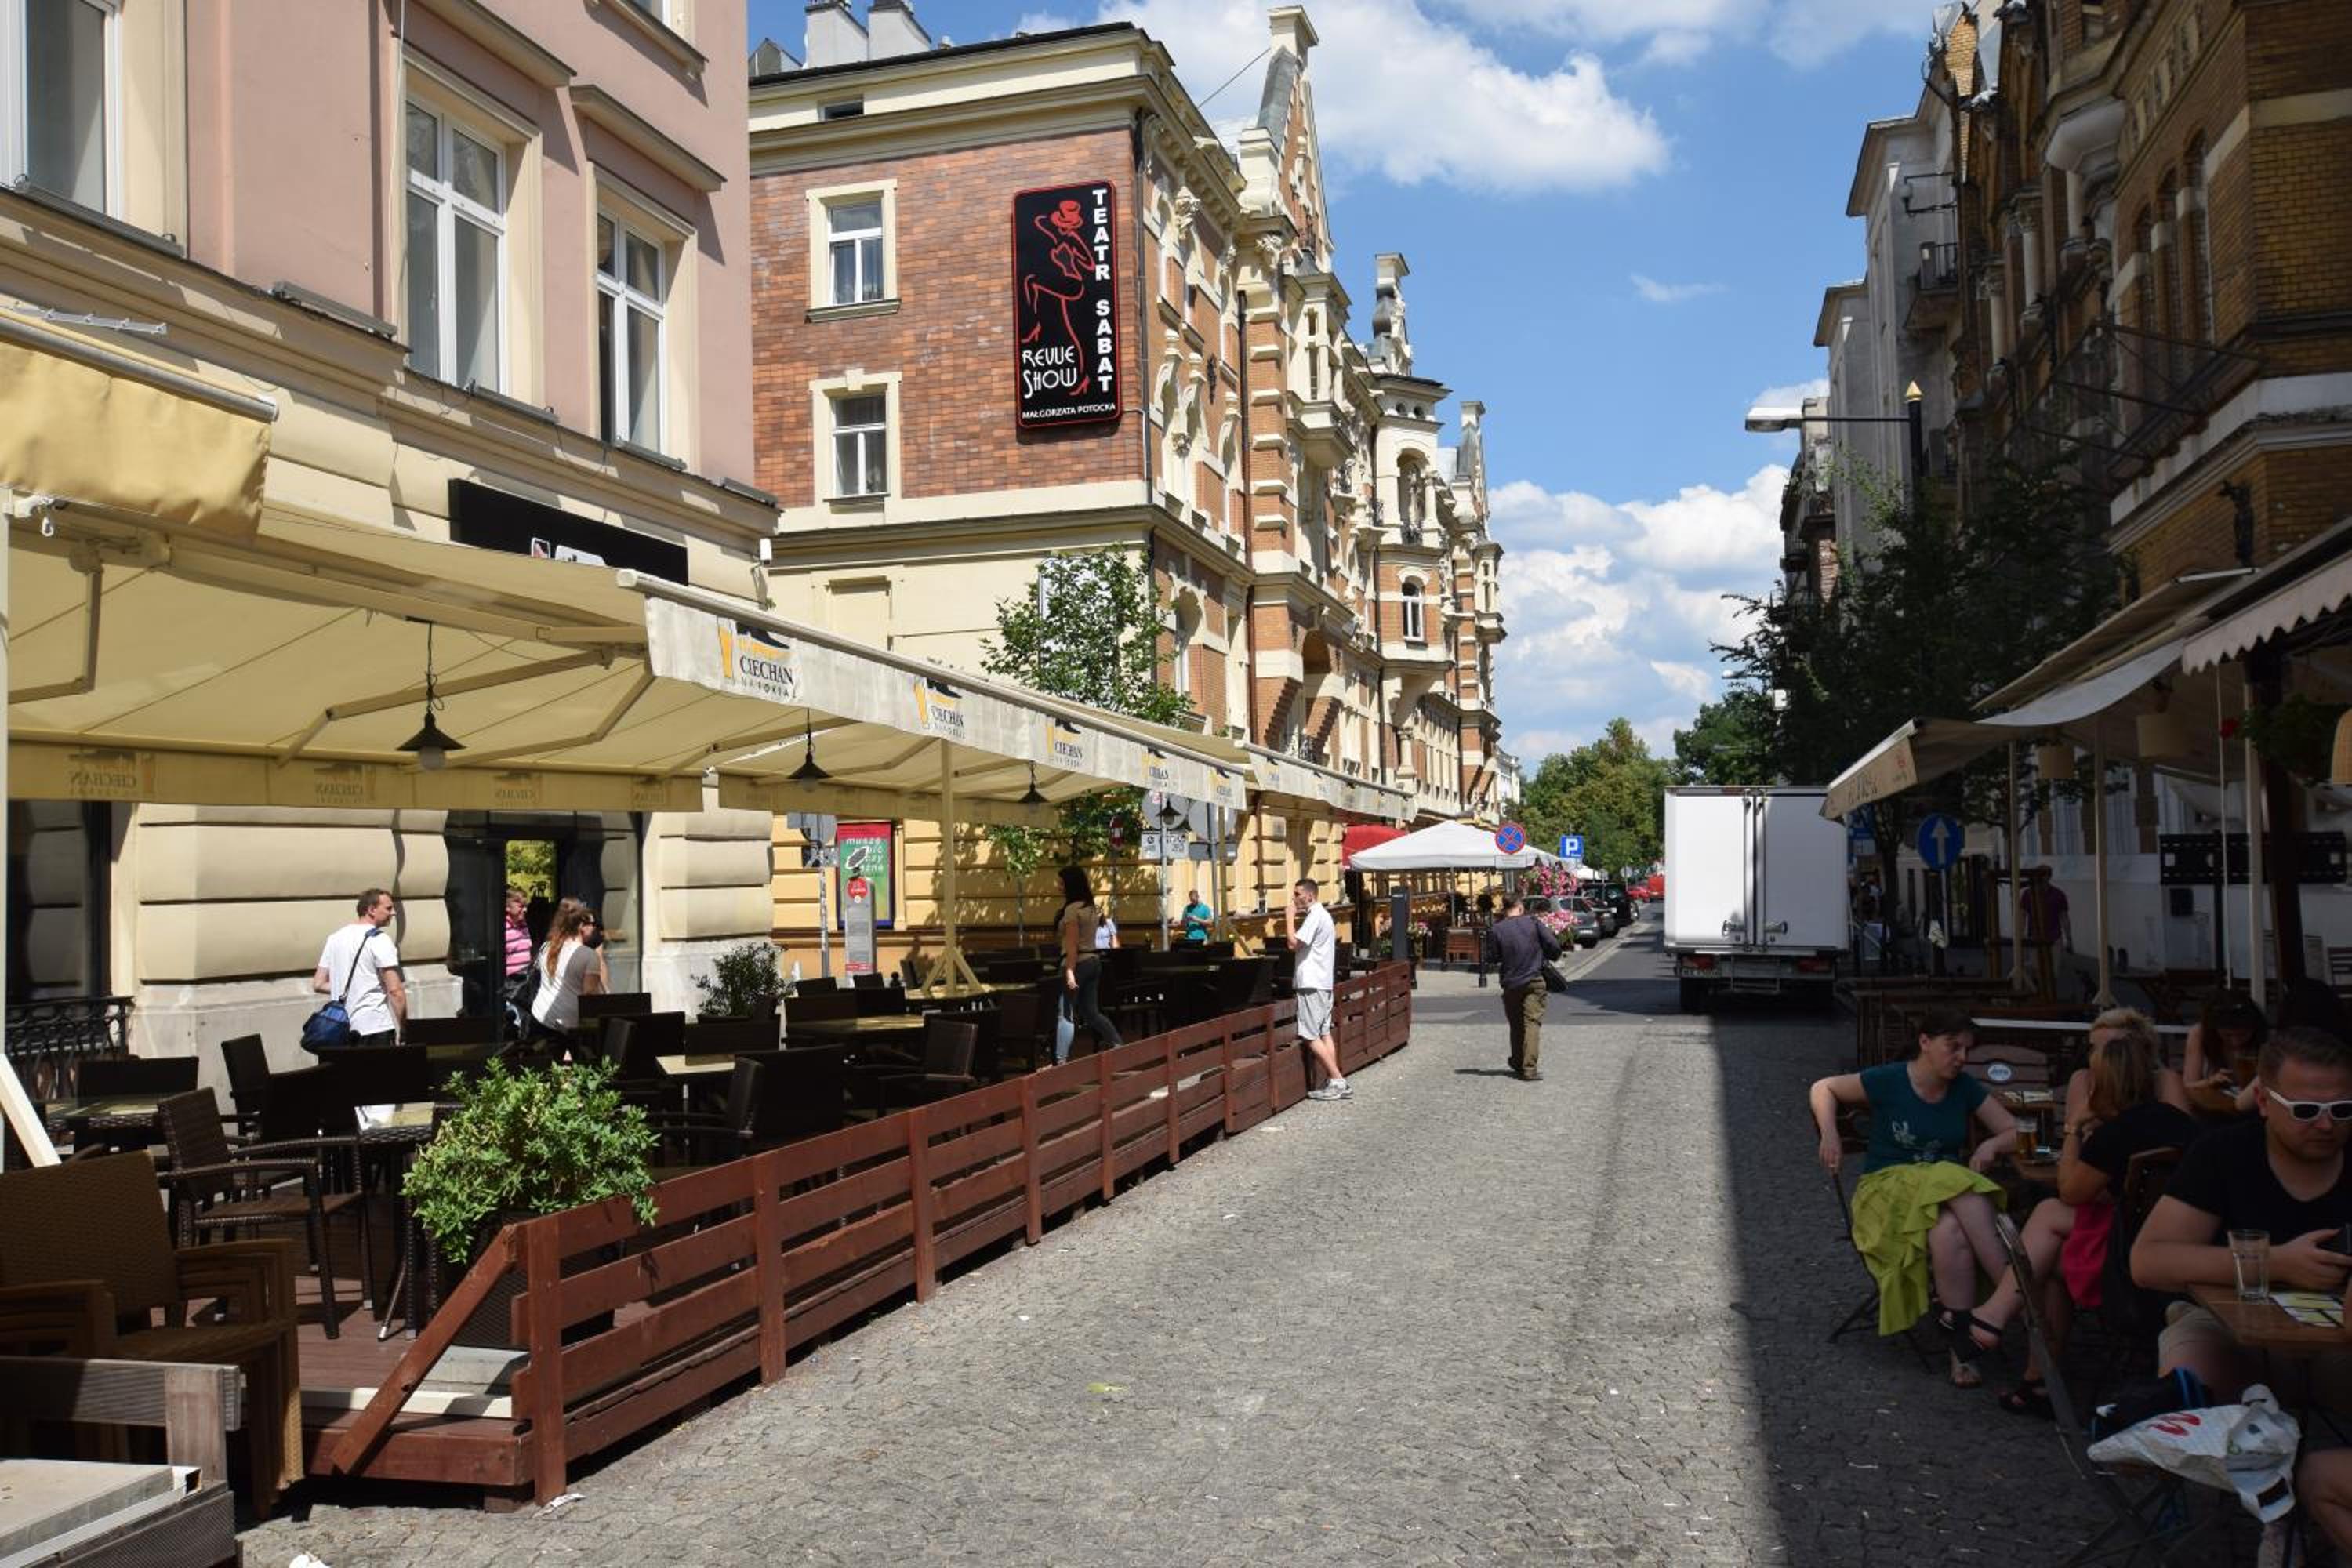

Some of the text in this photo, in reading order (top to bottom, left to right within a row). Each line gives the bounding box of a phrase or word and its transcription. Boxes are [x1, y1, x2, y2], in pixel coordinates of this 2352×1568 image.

[1092, 189, 1110, 281] TEATR
[1022, 345, 1076, 368] REVUE
[1095, 299, 1114, 392] SABAT
[1023, 367, 1077, 399] SHOW
[1077, 402, 1116, 414] POTOCKA
[1566, 838, 1578, 856] P
